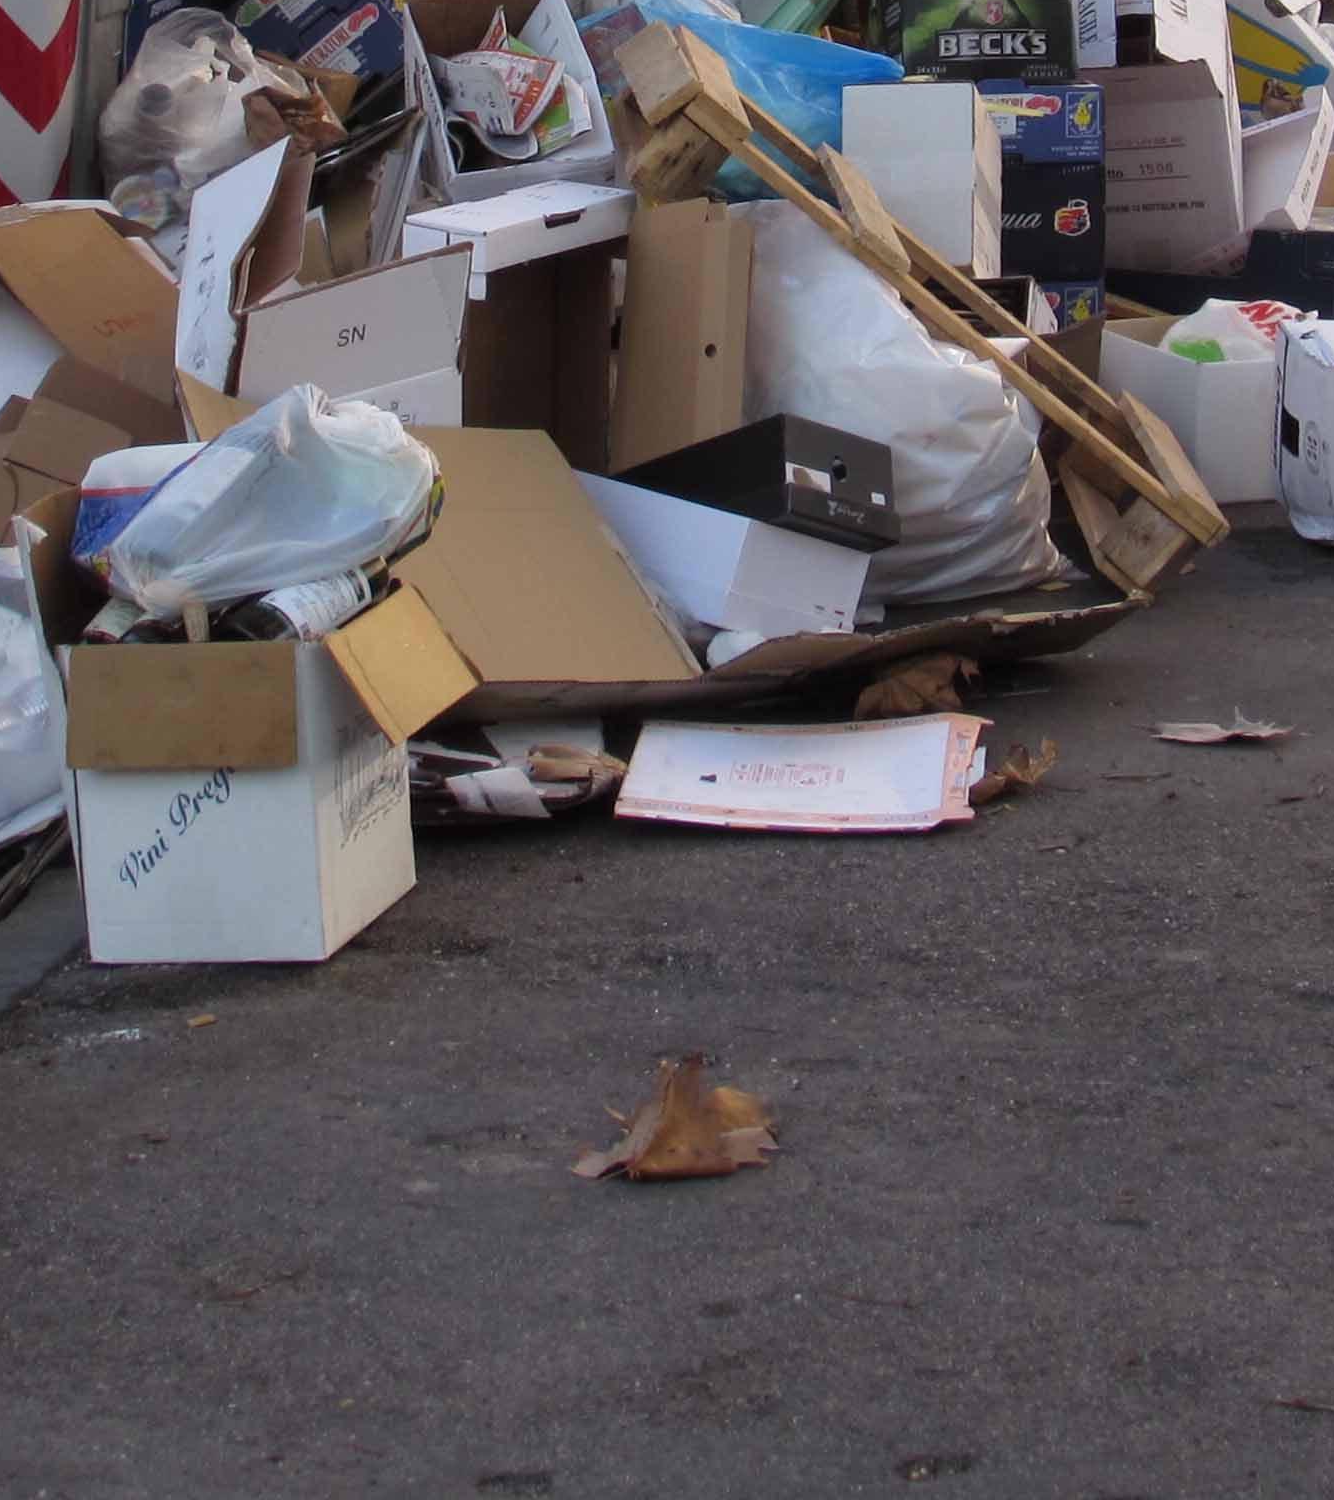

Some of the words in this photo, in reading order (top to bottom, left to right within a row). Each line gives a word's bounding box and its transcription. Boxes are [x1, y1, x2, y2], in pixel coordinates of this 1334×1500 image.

[938, 29, 1048, 57] BECK'S
[337, 324, 366, 347] SN
[119, 828, 170, 889] Vini
[169, 767, 235, 836] Preg
